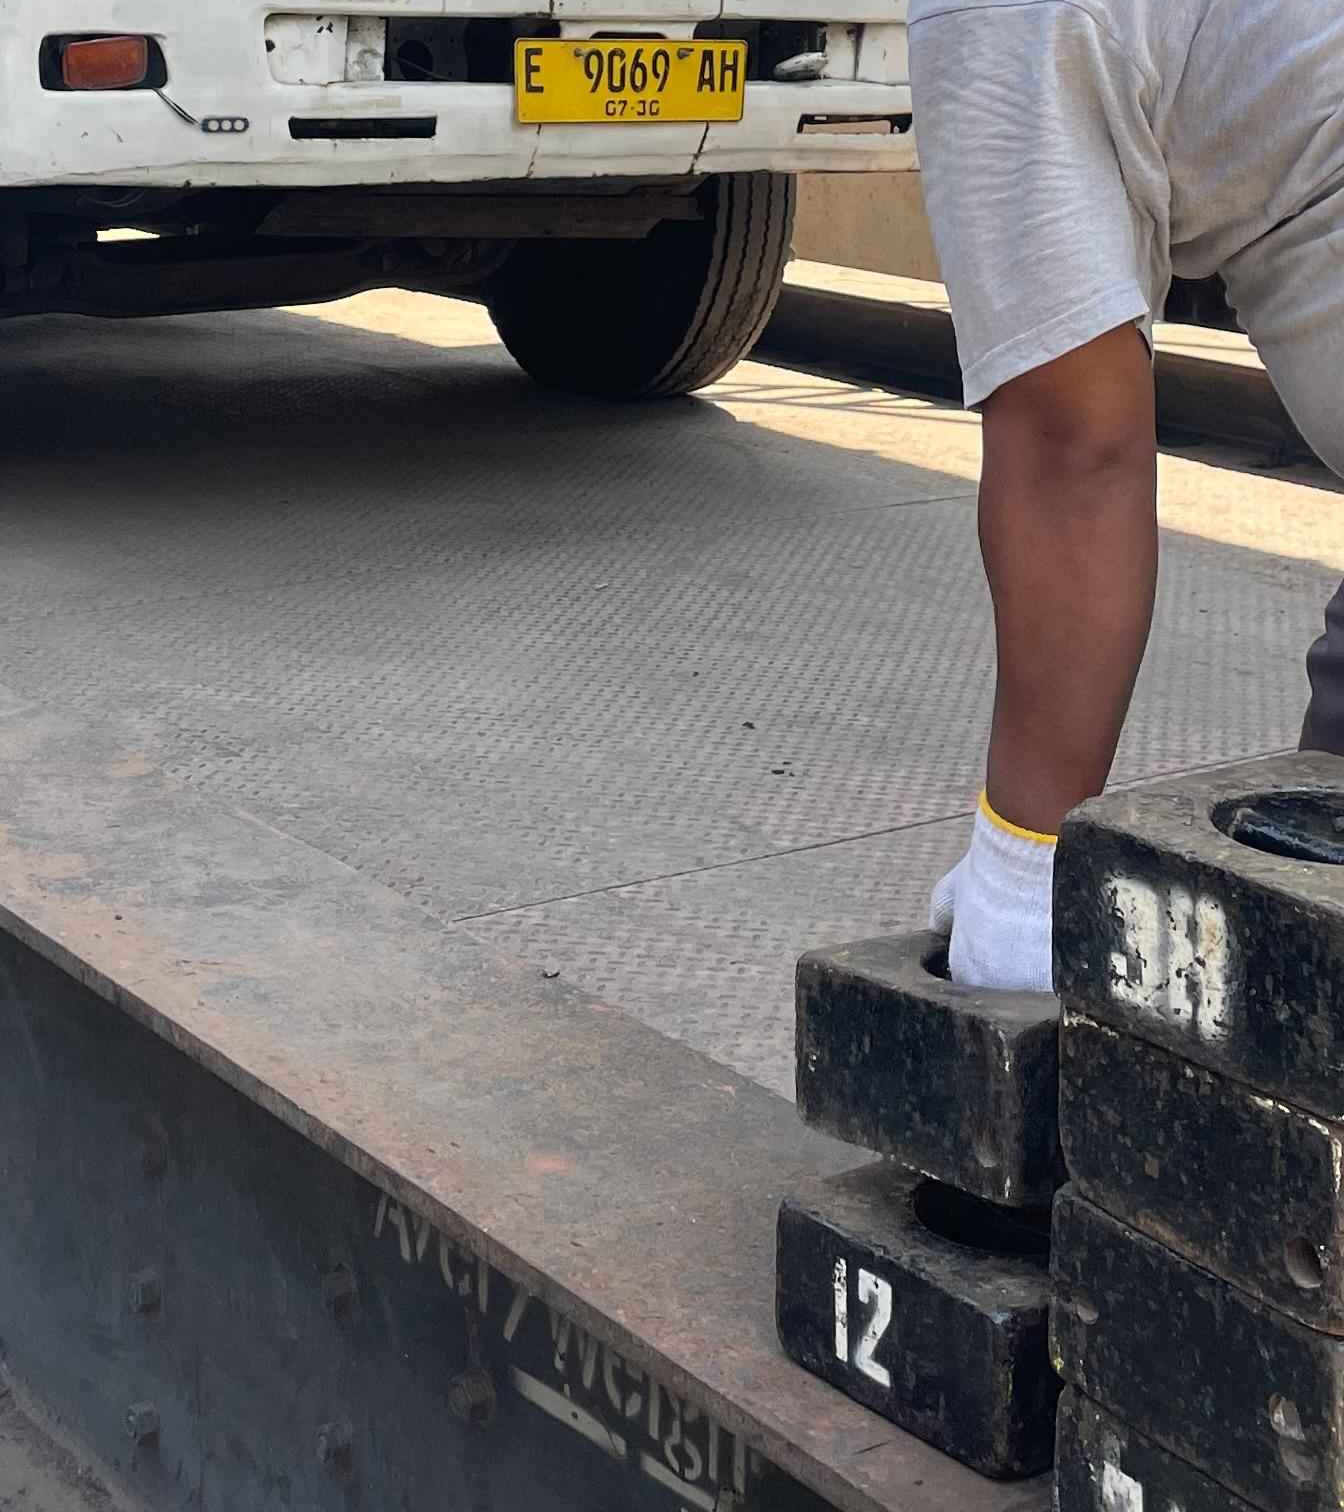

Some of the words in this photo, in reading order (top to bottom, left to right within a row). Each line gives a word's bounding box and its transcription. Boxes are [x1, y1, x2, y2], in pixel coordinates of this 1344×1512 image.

[523, 47, 545, 94] E
[583, 47, 671, 94] 9069
[696, 49, 740, 93] AH
[832, 1256, 893, 1387] 12
